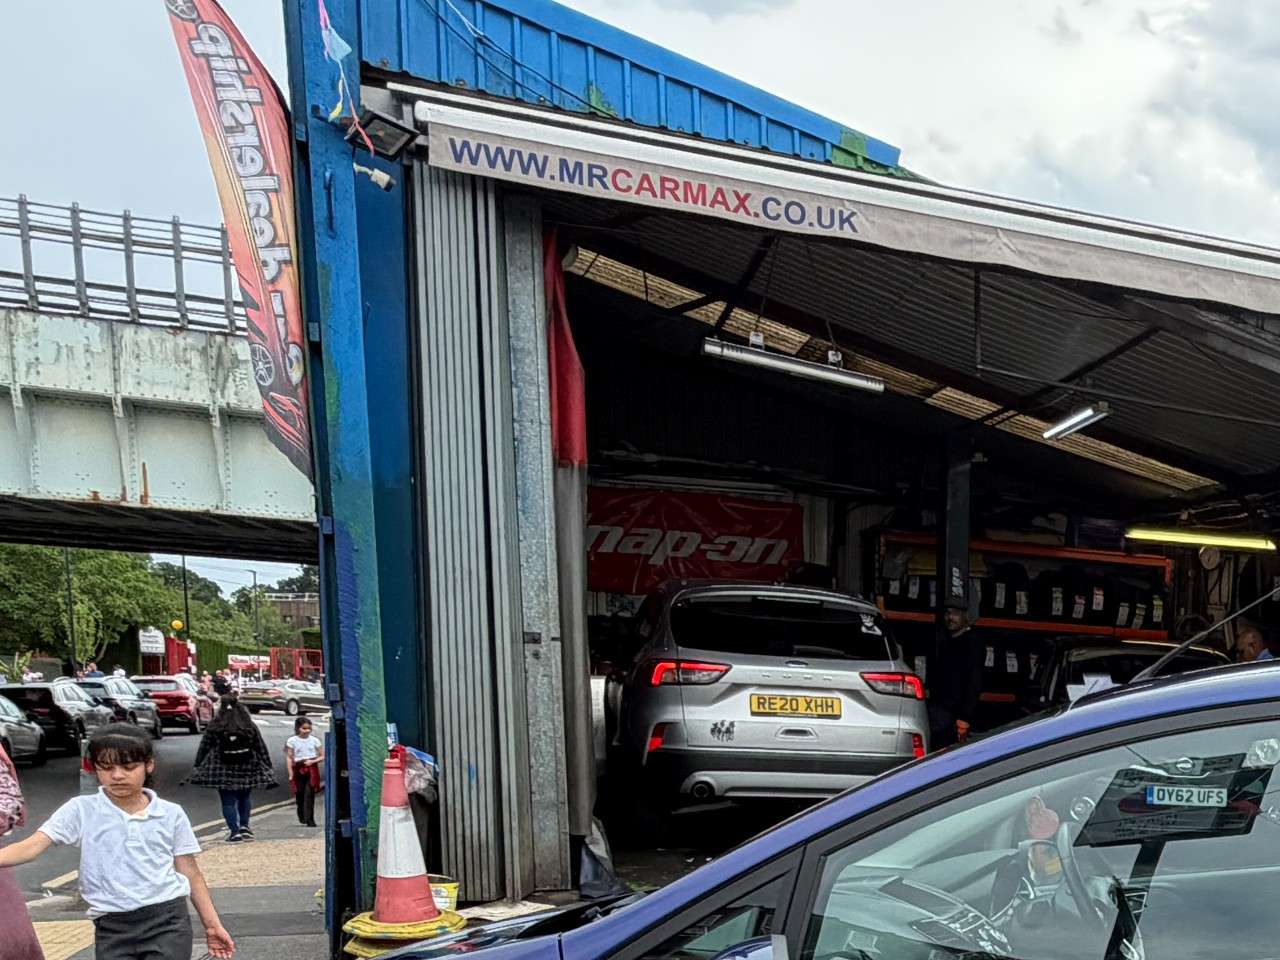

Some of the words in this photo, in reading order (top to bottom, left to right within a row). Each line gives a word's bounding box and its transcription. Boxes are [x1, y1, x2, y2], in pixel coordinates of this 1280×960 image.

[448, 137, 859, 234] WWW.MRCARMAX.CO.UK
[586, 525, 789, 566] nap-on
[757, 696, 800, 712] RE20
[804, 698, 835, 713] XHH
[1197, 790, 1224, 804] UFS
